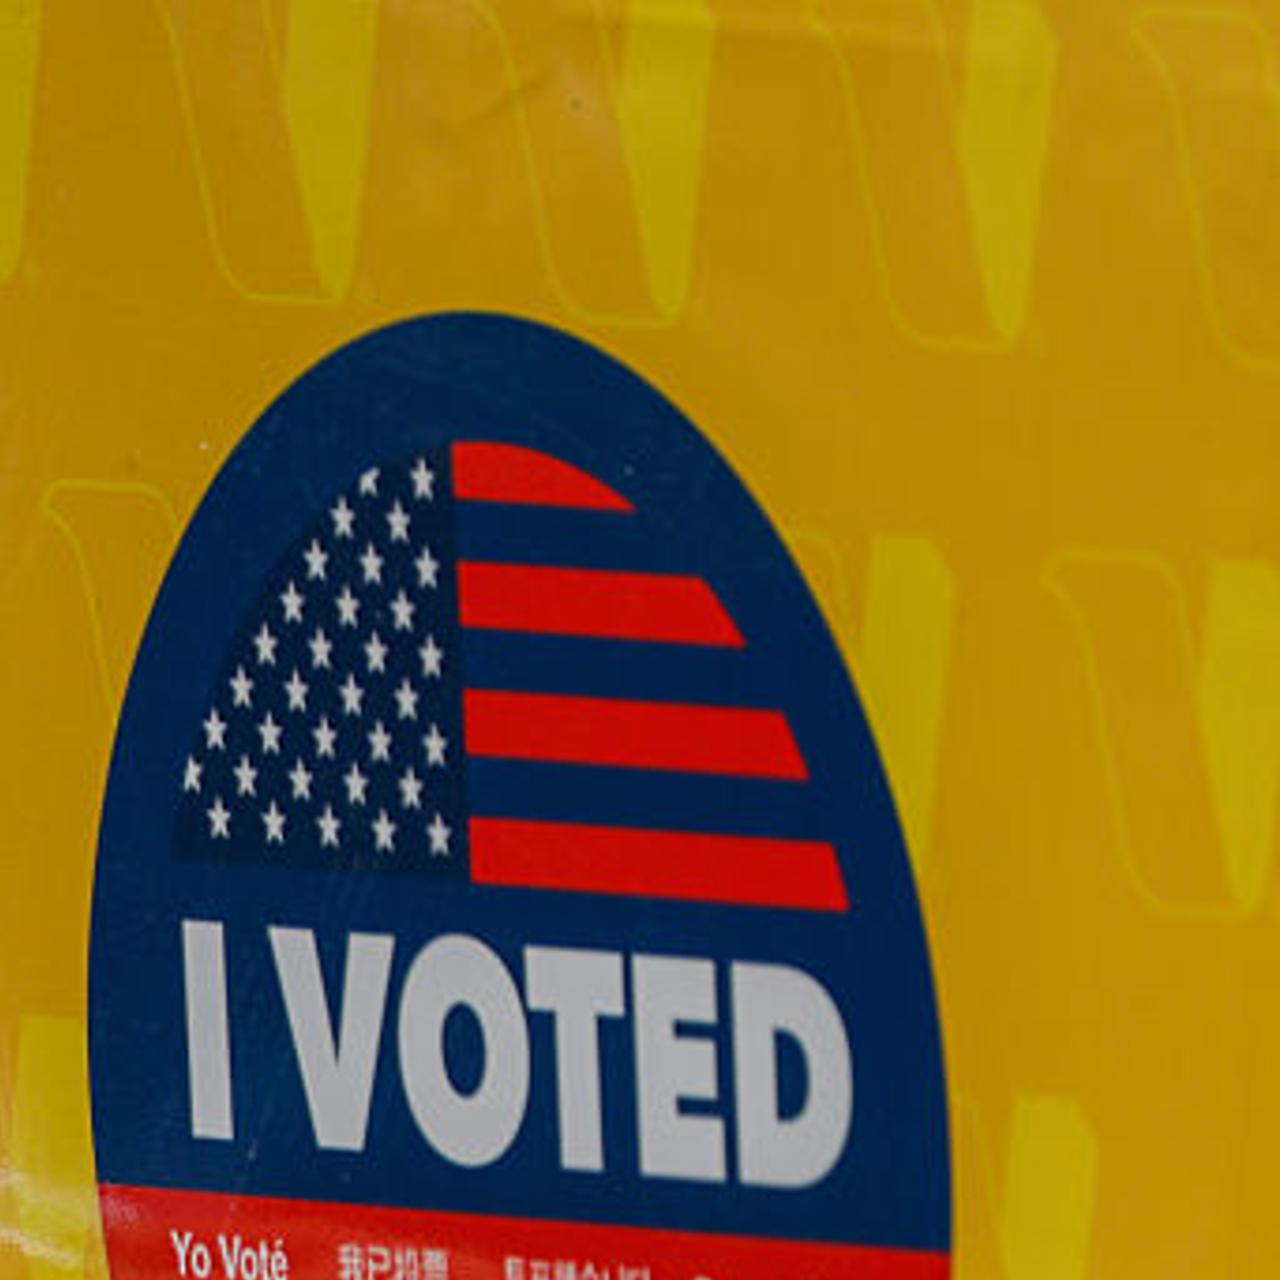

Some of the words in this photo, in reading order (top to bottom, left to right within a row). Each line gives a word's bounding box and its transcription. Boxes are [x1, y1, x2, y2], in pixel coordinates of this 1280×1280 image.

[180, 918, 235, 1142] I
[266, 924, 853, 1189] VOTED
[169, 1229, 212, 1280] Yo
